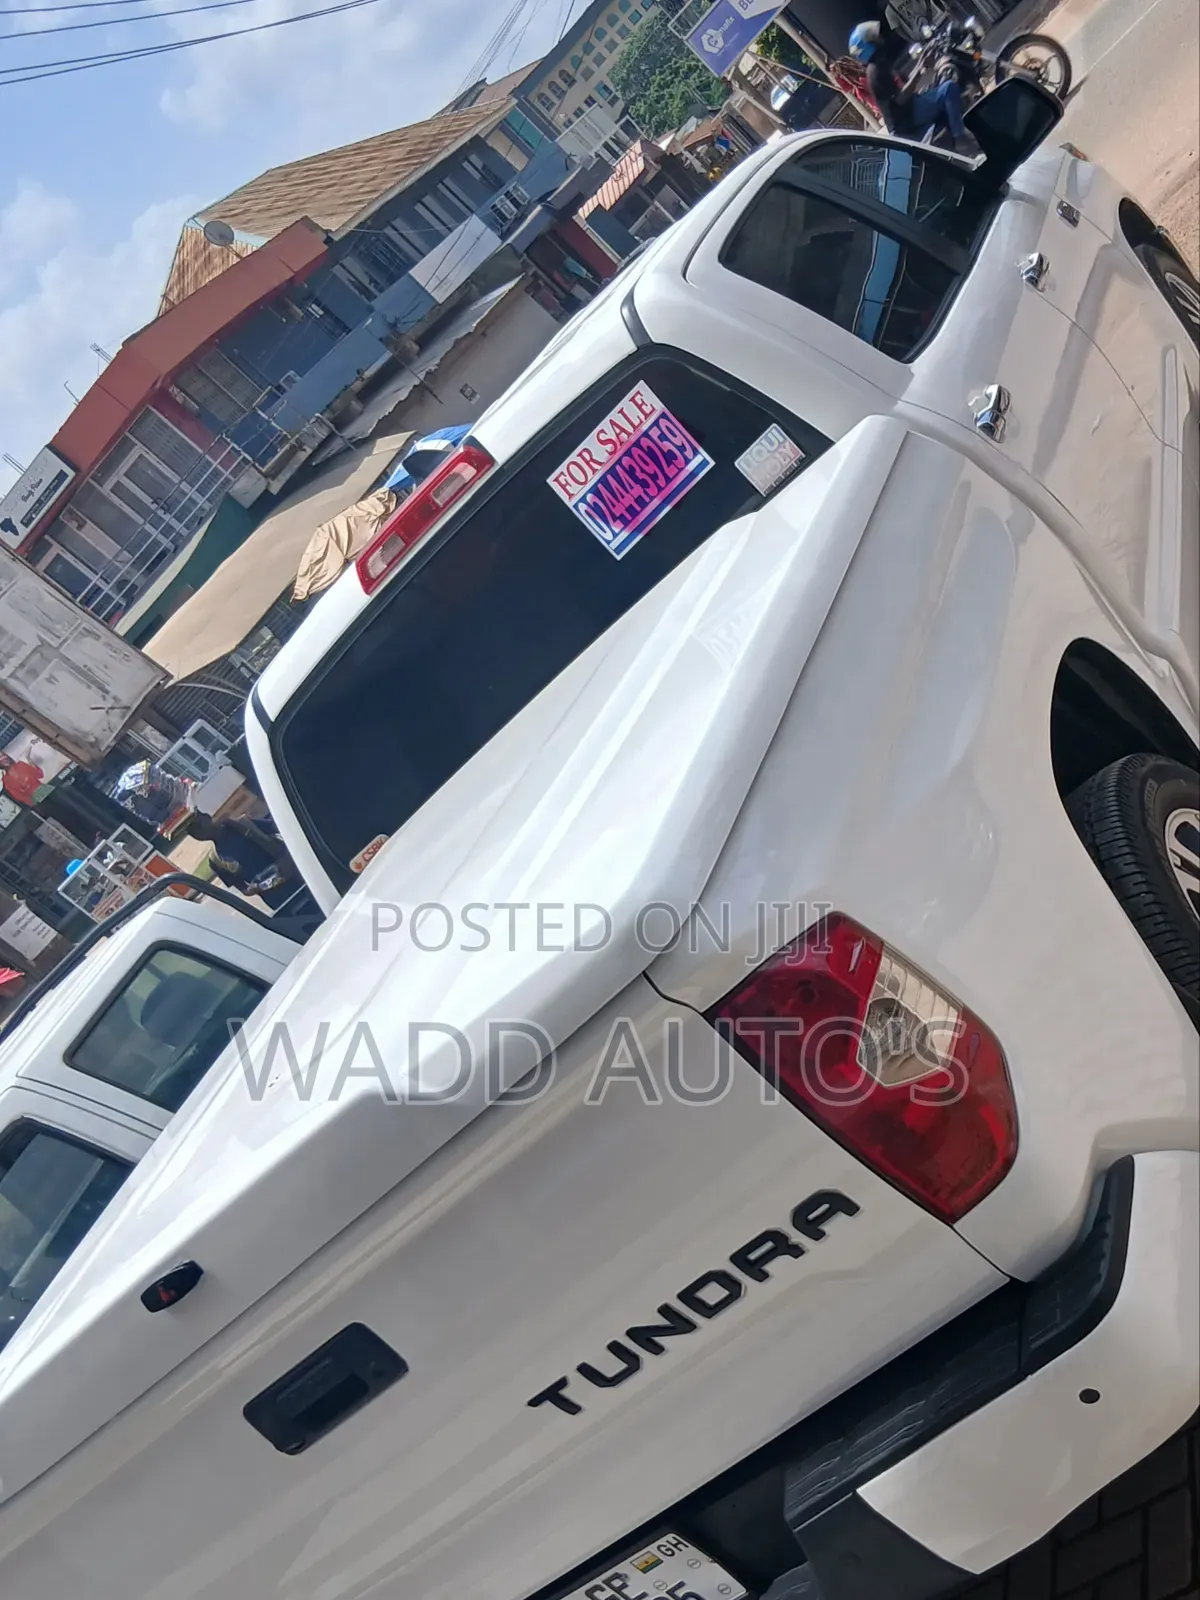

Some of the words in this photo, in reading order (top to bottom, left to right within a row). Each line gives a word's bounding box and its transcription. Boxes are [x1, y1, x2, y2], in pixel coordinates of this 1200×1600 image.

[553, 447, 604, 500] FOR
[596, 390, 657, 457] SALE
[577, 418, 694, 541] 0244439259
[740, 428, 785, 471] LIQUI
[750, 441, 796, 489] MOLY
[526, 1188, 861, 1416] TUNDRA
[656, 1536, 689, 1559] GH
